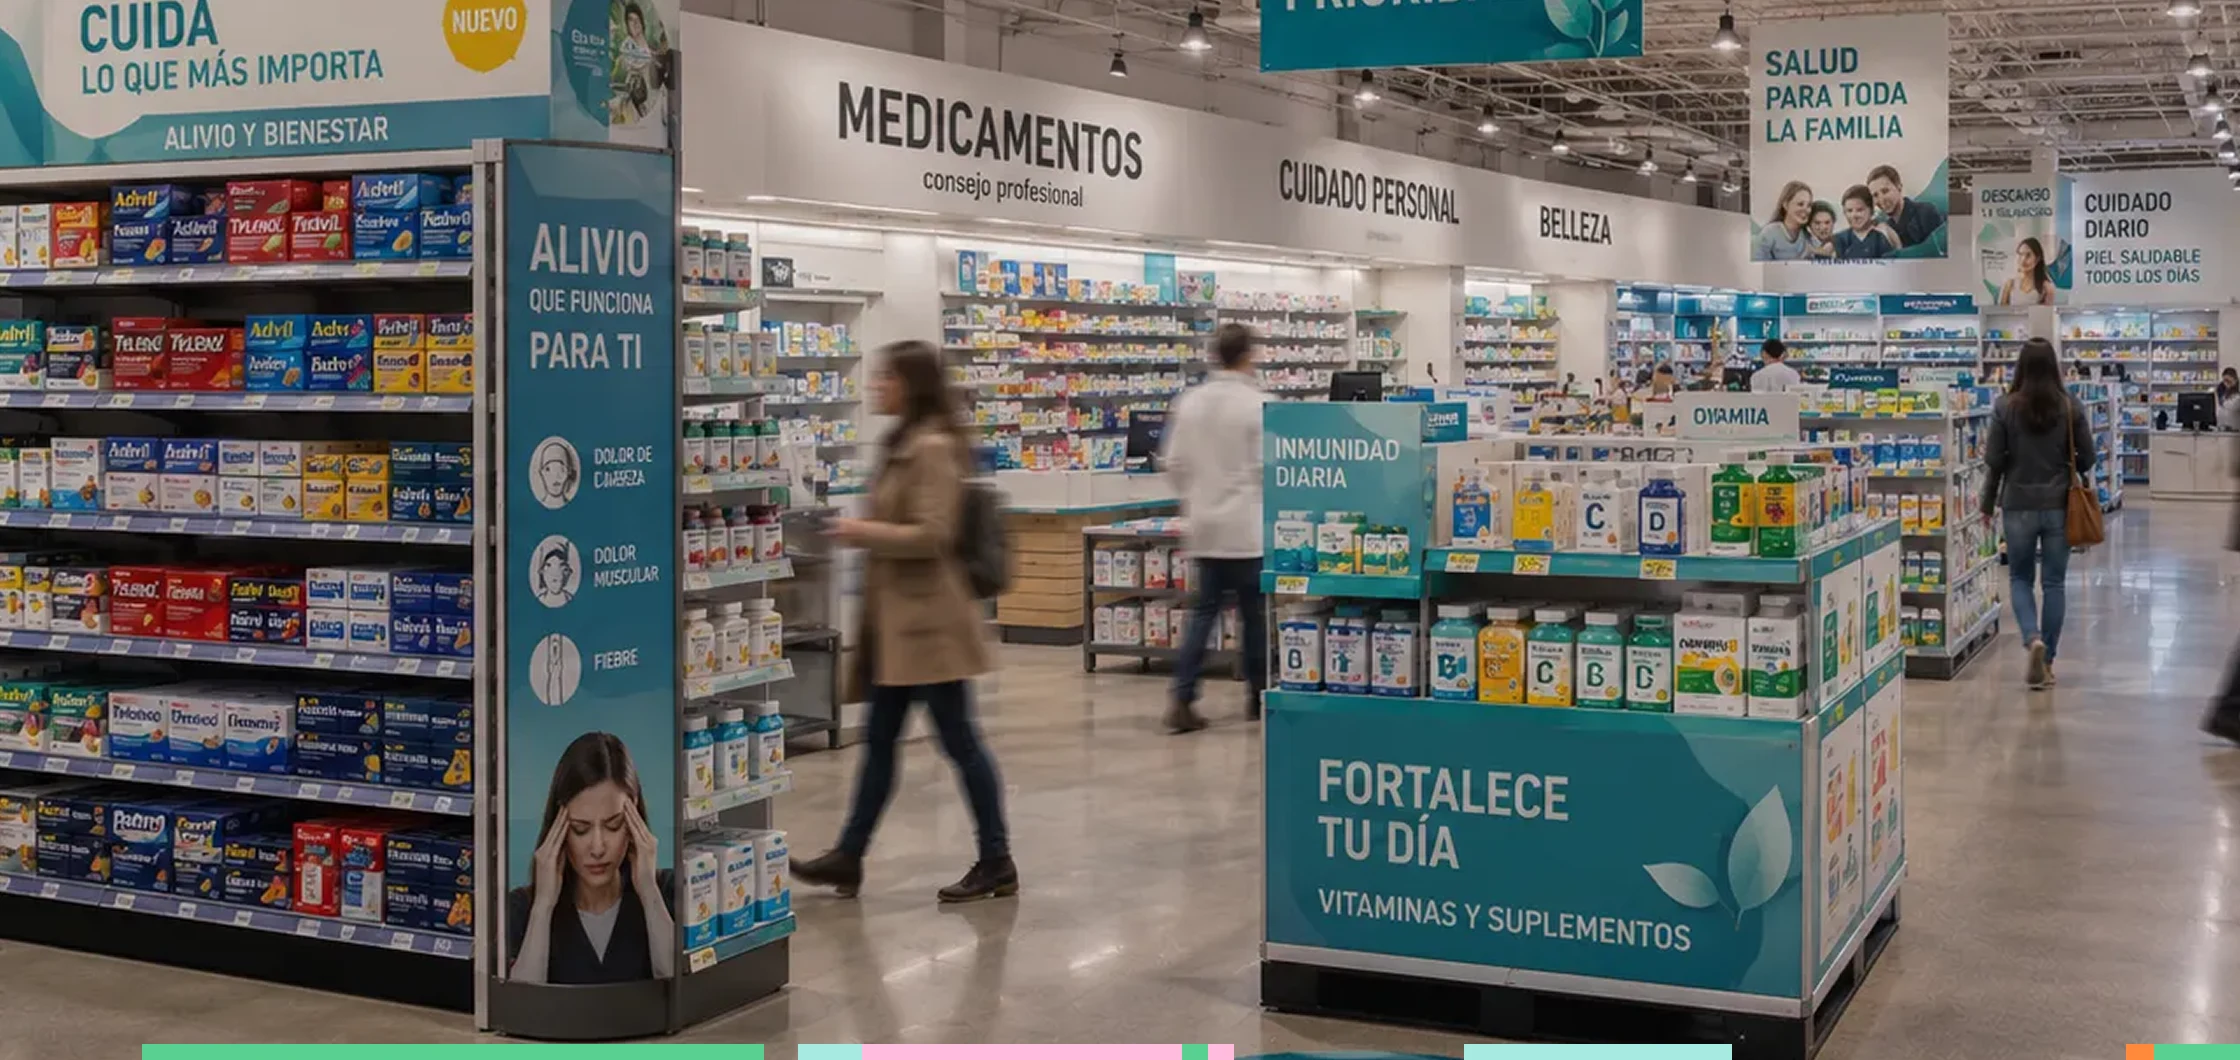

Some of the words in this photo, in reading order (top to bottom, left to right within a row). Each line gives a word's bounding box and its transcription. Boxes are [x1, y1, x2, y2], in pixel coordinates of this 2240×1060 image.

[80, 0, 218, 53] CUIDA
[452, 7, 518, 34] NUEVO
[82, 63, 115, 94] LO
[124, 60, 178, 95] QUE
[188, 49, 248, 89] MÁS
[258, 49, 384, 84] IMPORTA
[1766, 47, 1858, 76] SALUD
[1766, 84, 1833, 110] PARA
[1840, 81, 1908, 107] TODA
[164, 122, 236, 151] ALIVIO
[243, 121, 256, 147] Y
[264, 115, 389, 147] BIENESTAR
[838, 81, 1143, 180] MEDICAMENTOS
[1766, 117, 1797, 143] LA
[1805, 114, 1903, 141] FAMILIA
[923, 170, 991, 201] consejo
[997, 177, 1083, 207] profesional
[1279, 158, 1367, 211] CUIDADO
[1372, 176, 1460, 225] PERSONAL
[2085, 191, 2172, 213] CUIDADO
[1540, 205, 1613, 246] BELLEZA
[2085, 217, 2150, 239] DIARIO
[529, 222, 650, 277] ALIVIO
[2085, 249, 2116, 264] PIEL
[2085, 269, 2132, 284] TODOS
[2135, 269, 2163, 284] LOS
[529, 288, 566, 314] QUE
[571, 289, 654, 315] FUNCIONA
[530, 331, 610, 369] PARA
[617, 332, 642, 369] TI
[594, 447, 635, 465] DOLOR
[637, 445, 653, 463] DE
[1275, 437, 1400, 461] INMUNIDAD
[1276, 466, 1347, 489] DIARIA
[1586, 502, 1605, 530] C
[1650, 511, 1665, 531] D
[594, 545, 636, 565] DOLOR
[594, 566, 660, 588] MUSCULAR
[594, 648, 639, 671] FIEBRE
[1537, 660, 1554, 684] C
[1586, 662, 1605, 687] B
[1318, 758, 1569, 821] FORTALECE
[1318, 815, 1370, 861] TU
[1387, 813, 1460, 870] DÍA
[1318, 888, 1457, 928] VITAMINAS
[1464, 903, 1481, 929] Y
[1488, 905, 1692, 952] SUPLEMENTOS
